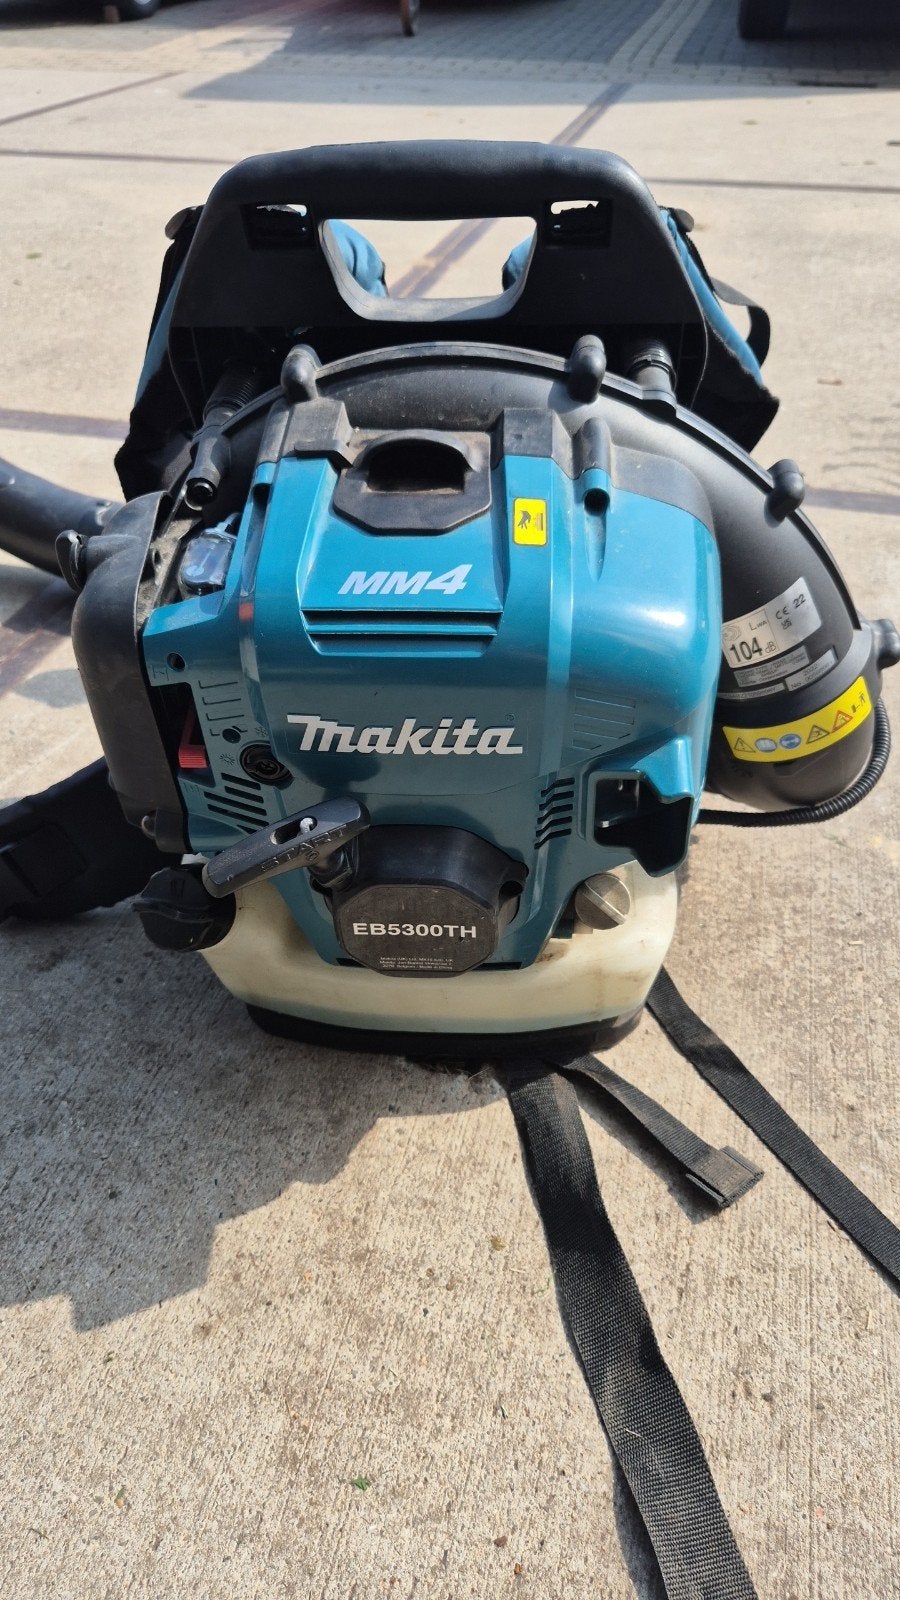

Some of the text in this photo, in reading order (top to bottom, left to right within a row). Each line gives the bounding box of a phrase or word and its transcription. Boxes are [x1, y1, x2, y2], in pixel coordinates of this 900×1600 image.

[338, 564, 473, 595] MM4
[730, 637, 763, 663] 104
[352, 922, 477, 939] EB5300TH
